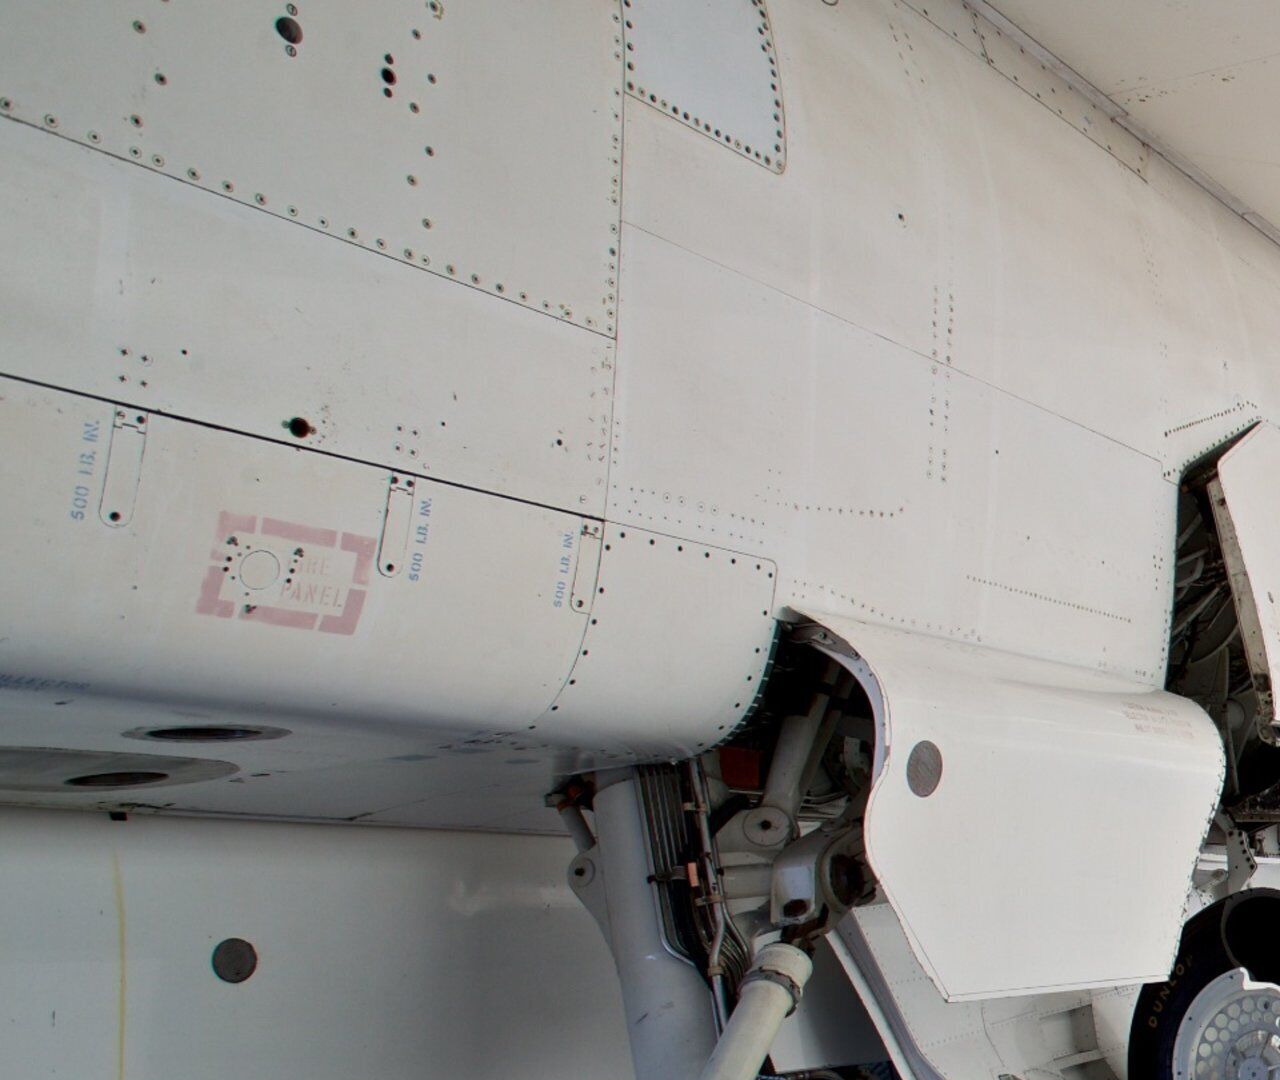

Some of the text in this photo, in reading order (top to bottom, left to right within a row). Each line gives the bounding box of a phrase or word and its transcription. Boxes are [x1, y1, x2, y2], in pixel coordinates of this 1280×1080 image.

[70, 486, 90, 521] 500
[82, 421, 100, 443] IN.
[408, 552, 423, 582] 500
[420, 498, 432, 517] IN.
[553, 581, 566, 608] 500
